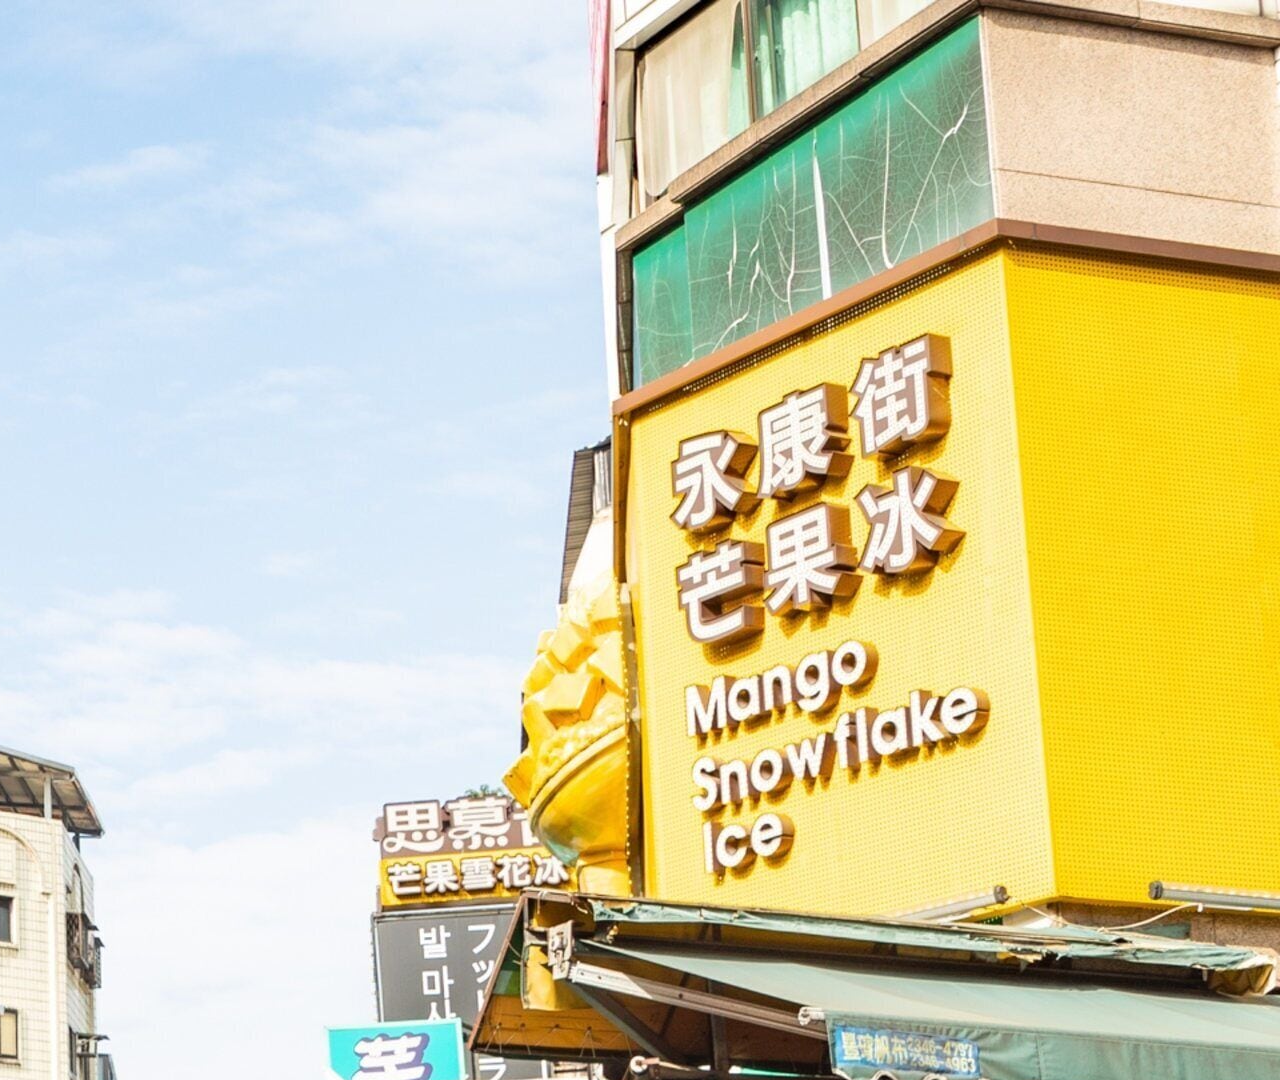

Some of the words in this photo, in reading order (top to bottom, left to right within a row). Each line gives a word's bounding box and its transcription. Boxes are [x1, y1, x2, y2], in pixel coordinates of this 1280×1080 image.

[671, 335, 945, 530] 永康街
[677, 468, 956, 642] 芒果冰
[686, 640, 873, 737] Mango
[692, 687, 989, 812] Snowflake
[387, 852, 569, 898] 芒果雪花冰
[703, 812, 793, 874] Ice
